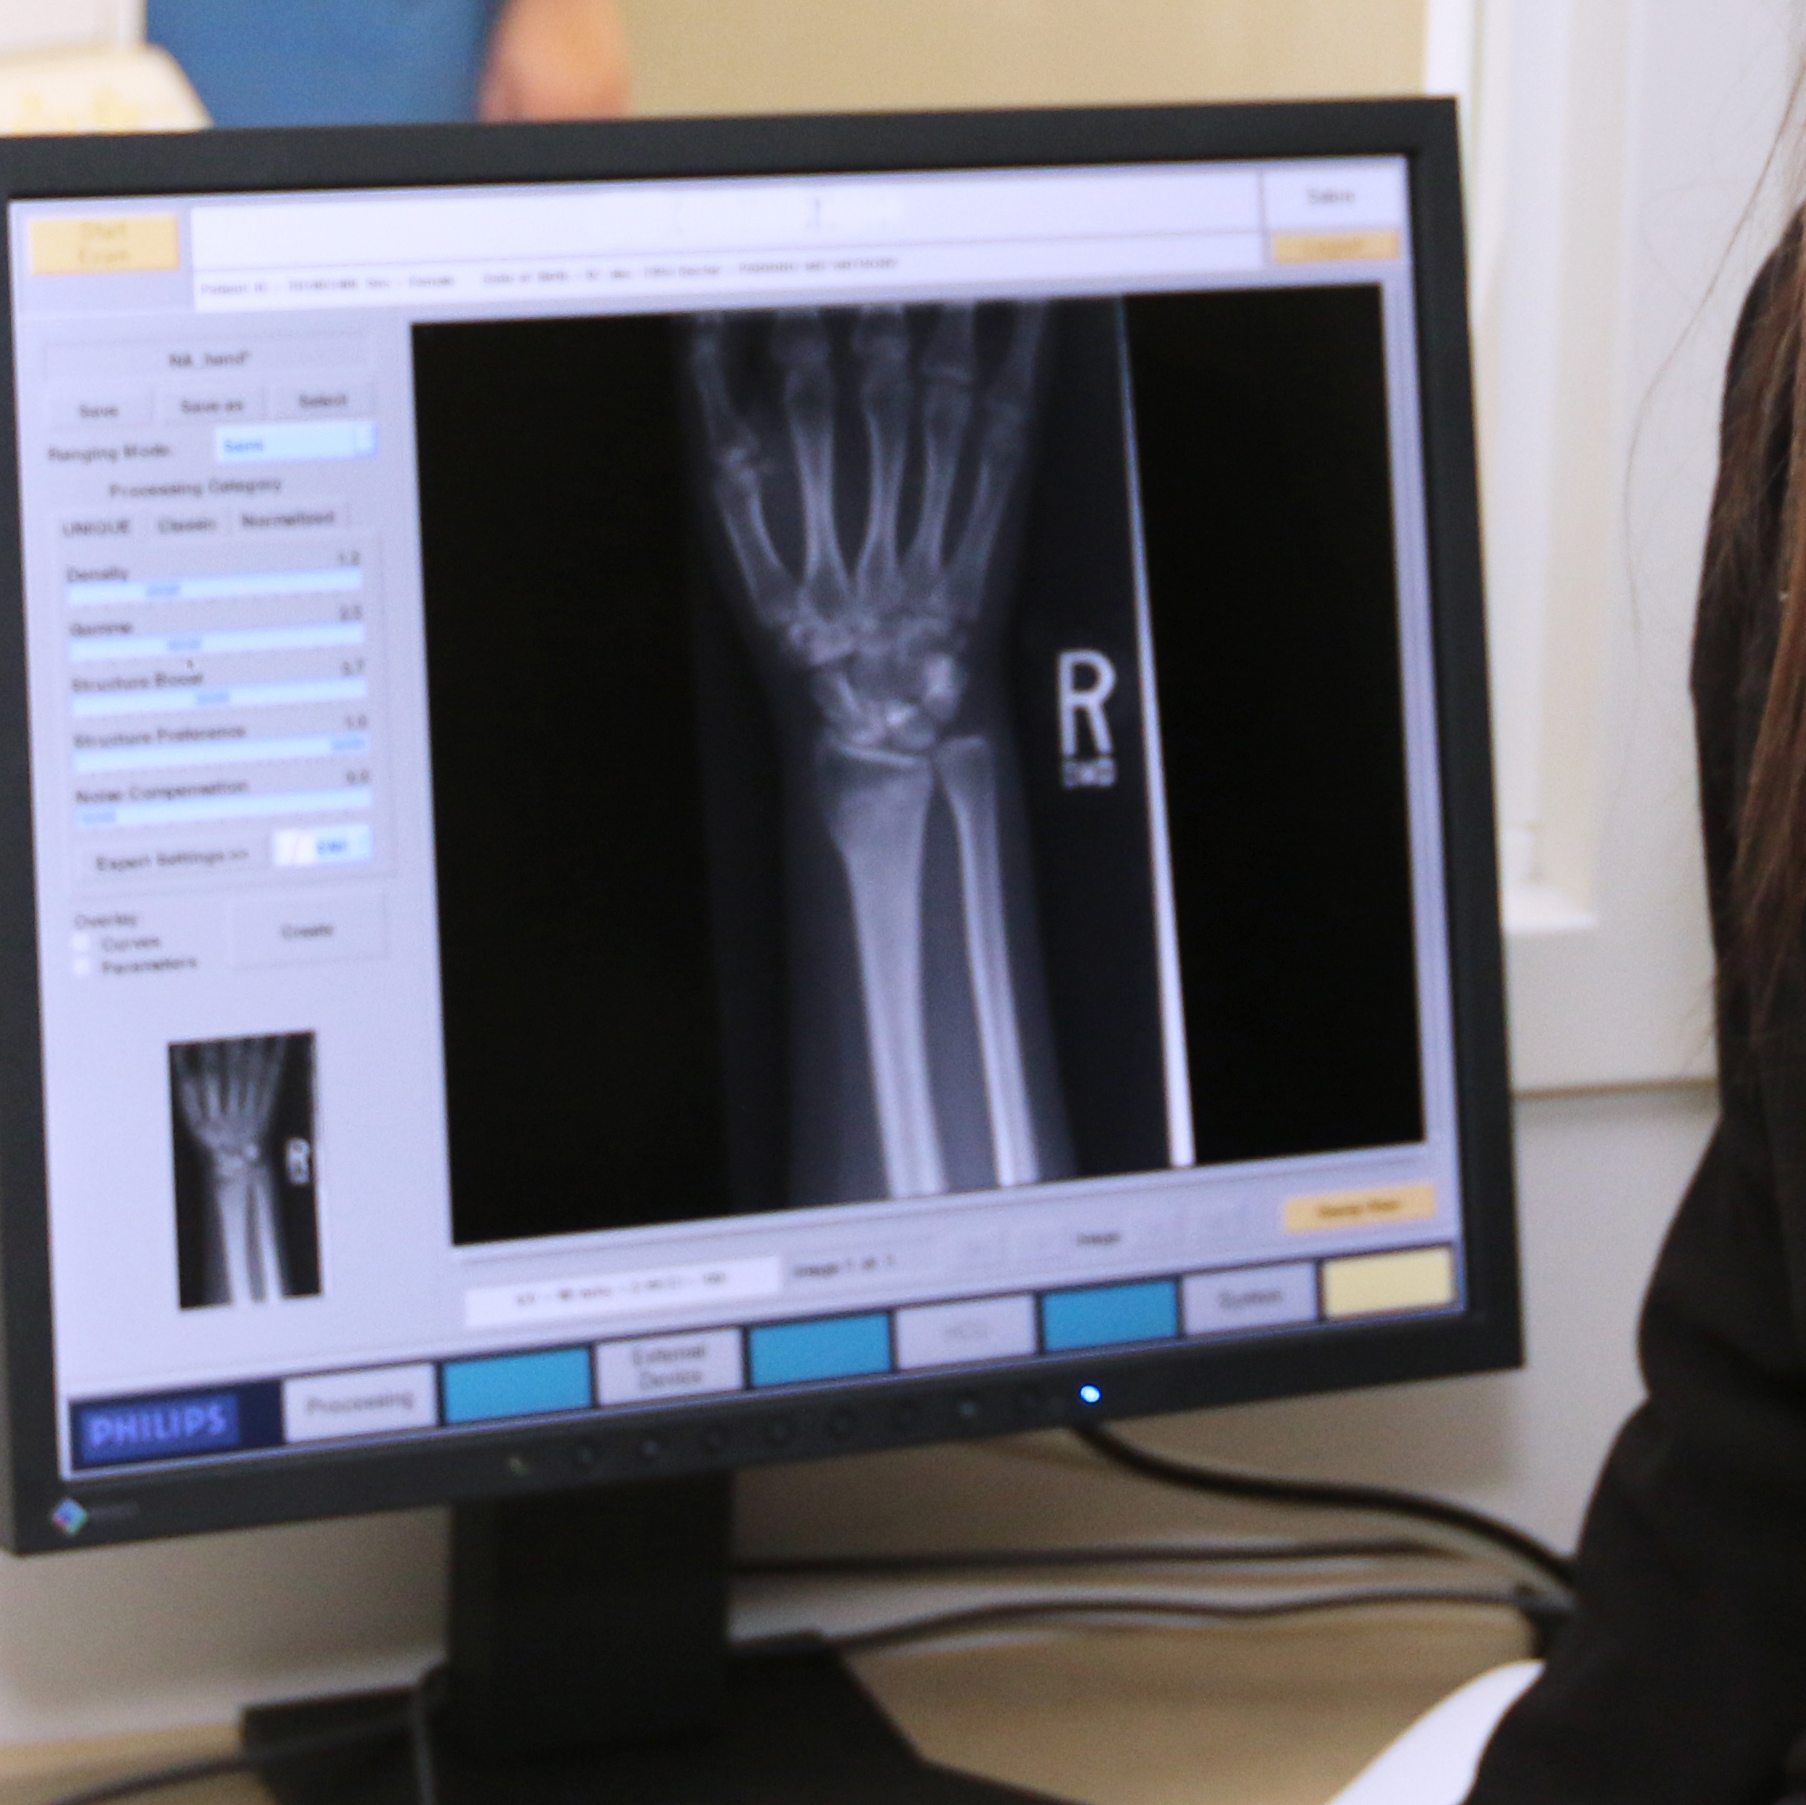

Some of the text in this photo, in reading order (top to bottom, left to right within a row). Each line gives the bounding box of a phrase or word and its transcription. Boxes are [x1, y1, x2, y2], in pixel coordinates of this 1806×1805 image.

[208, 476, 281, 496] Category
[1058, 649, 1117, 755] R
[89, 1404, 228, 1450] PHILIPS
